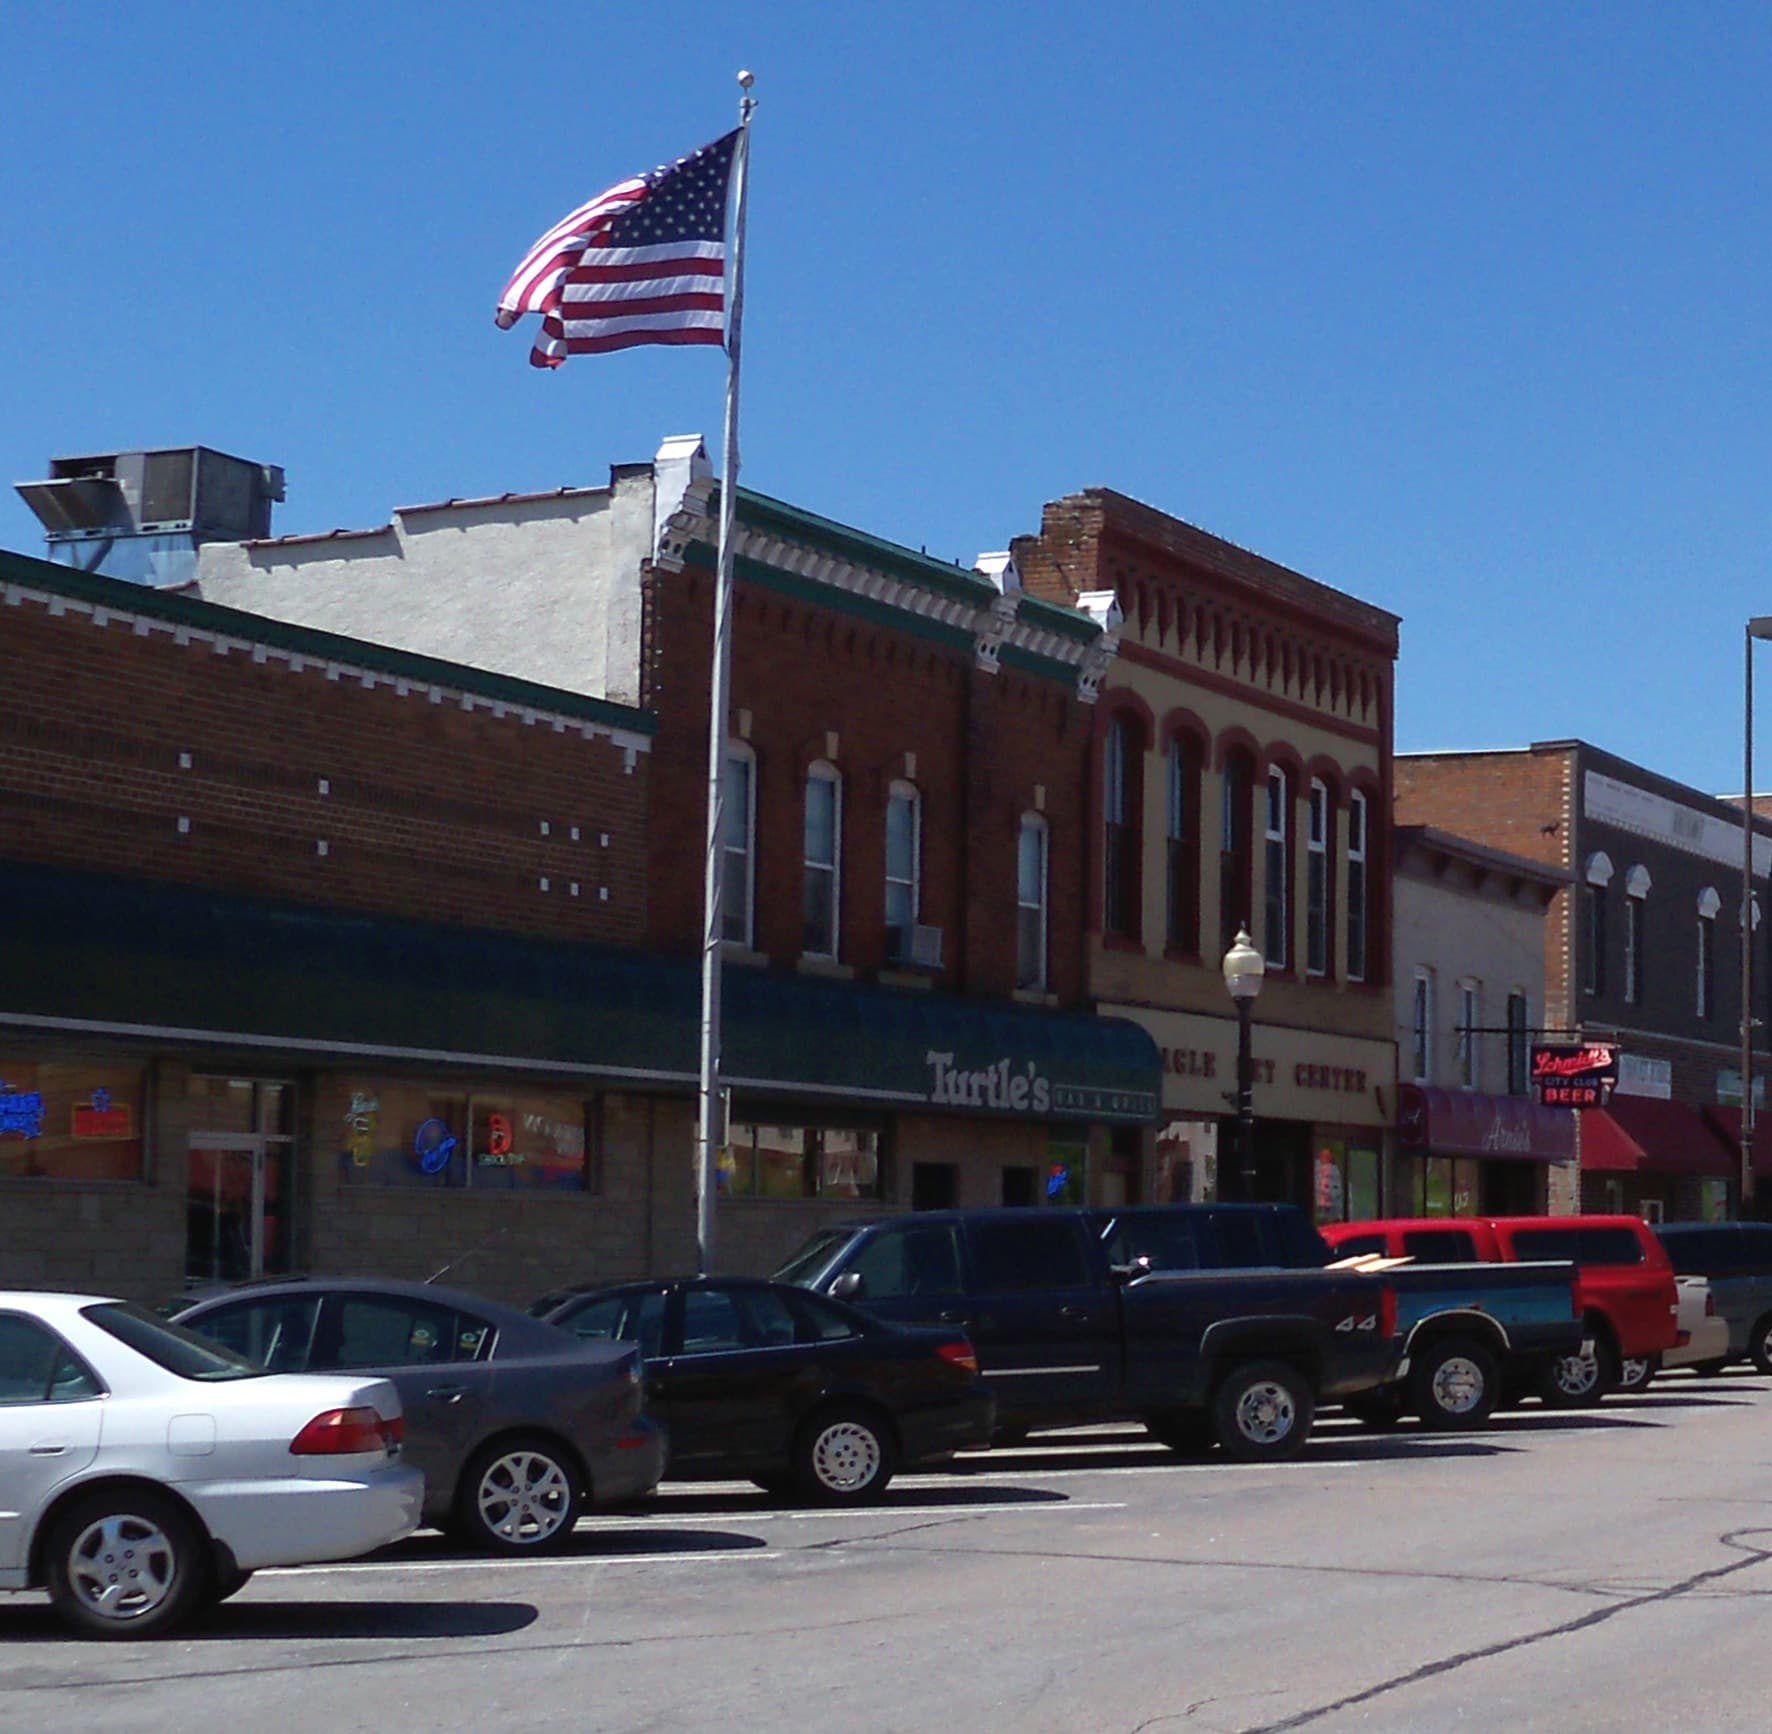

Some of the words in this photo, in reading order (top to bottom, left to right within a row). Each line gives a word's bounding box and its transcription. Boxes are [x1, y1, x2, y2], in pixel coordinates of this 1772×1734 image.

[925, 1050, 1049, 1112] Turtle's
[1293, 1062, 1367, 1093] CENTER
[1544, 1077, 1568, 1087] CITY
[1573, 1077, 1599, 1087] CLUB
[1545, 1088, 1596, 1103] BEER
